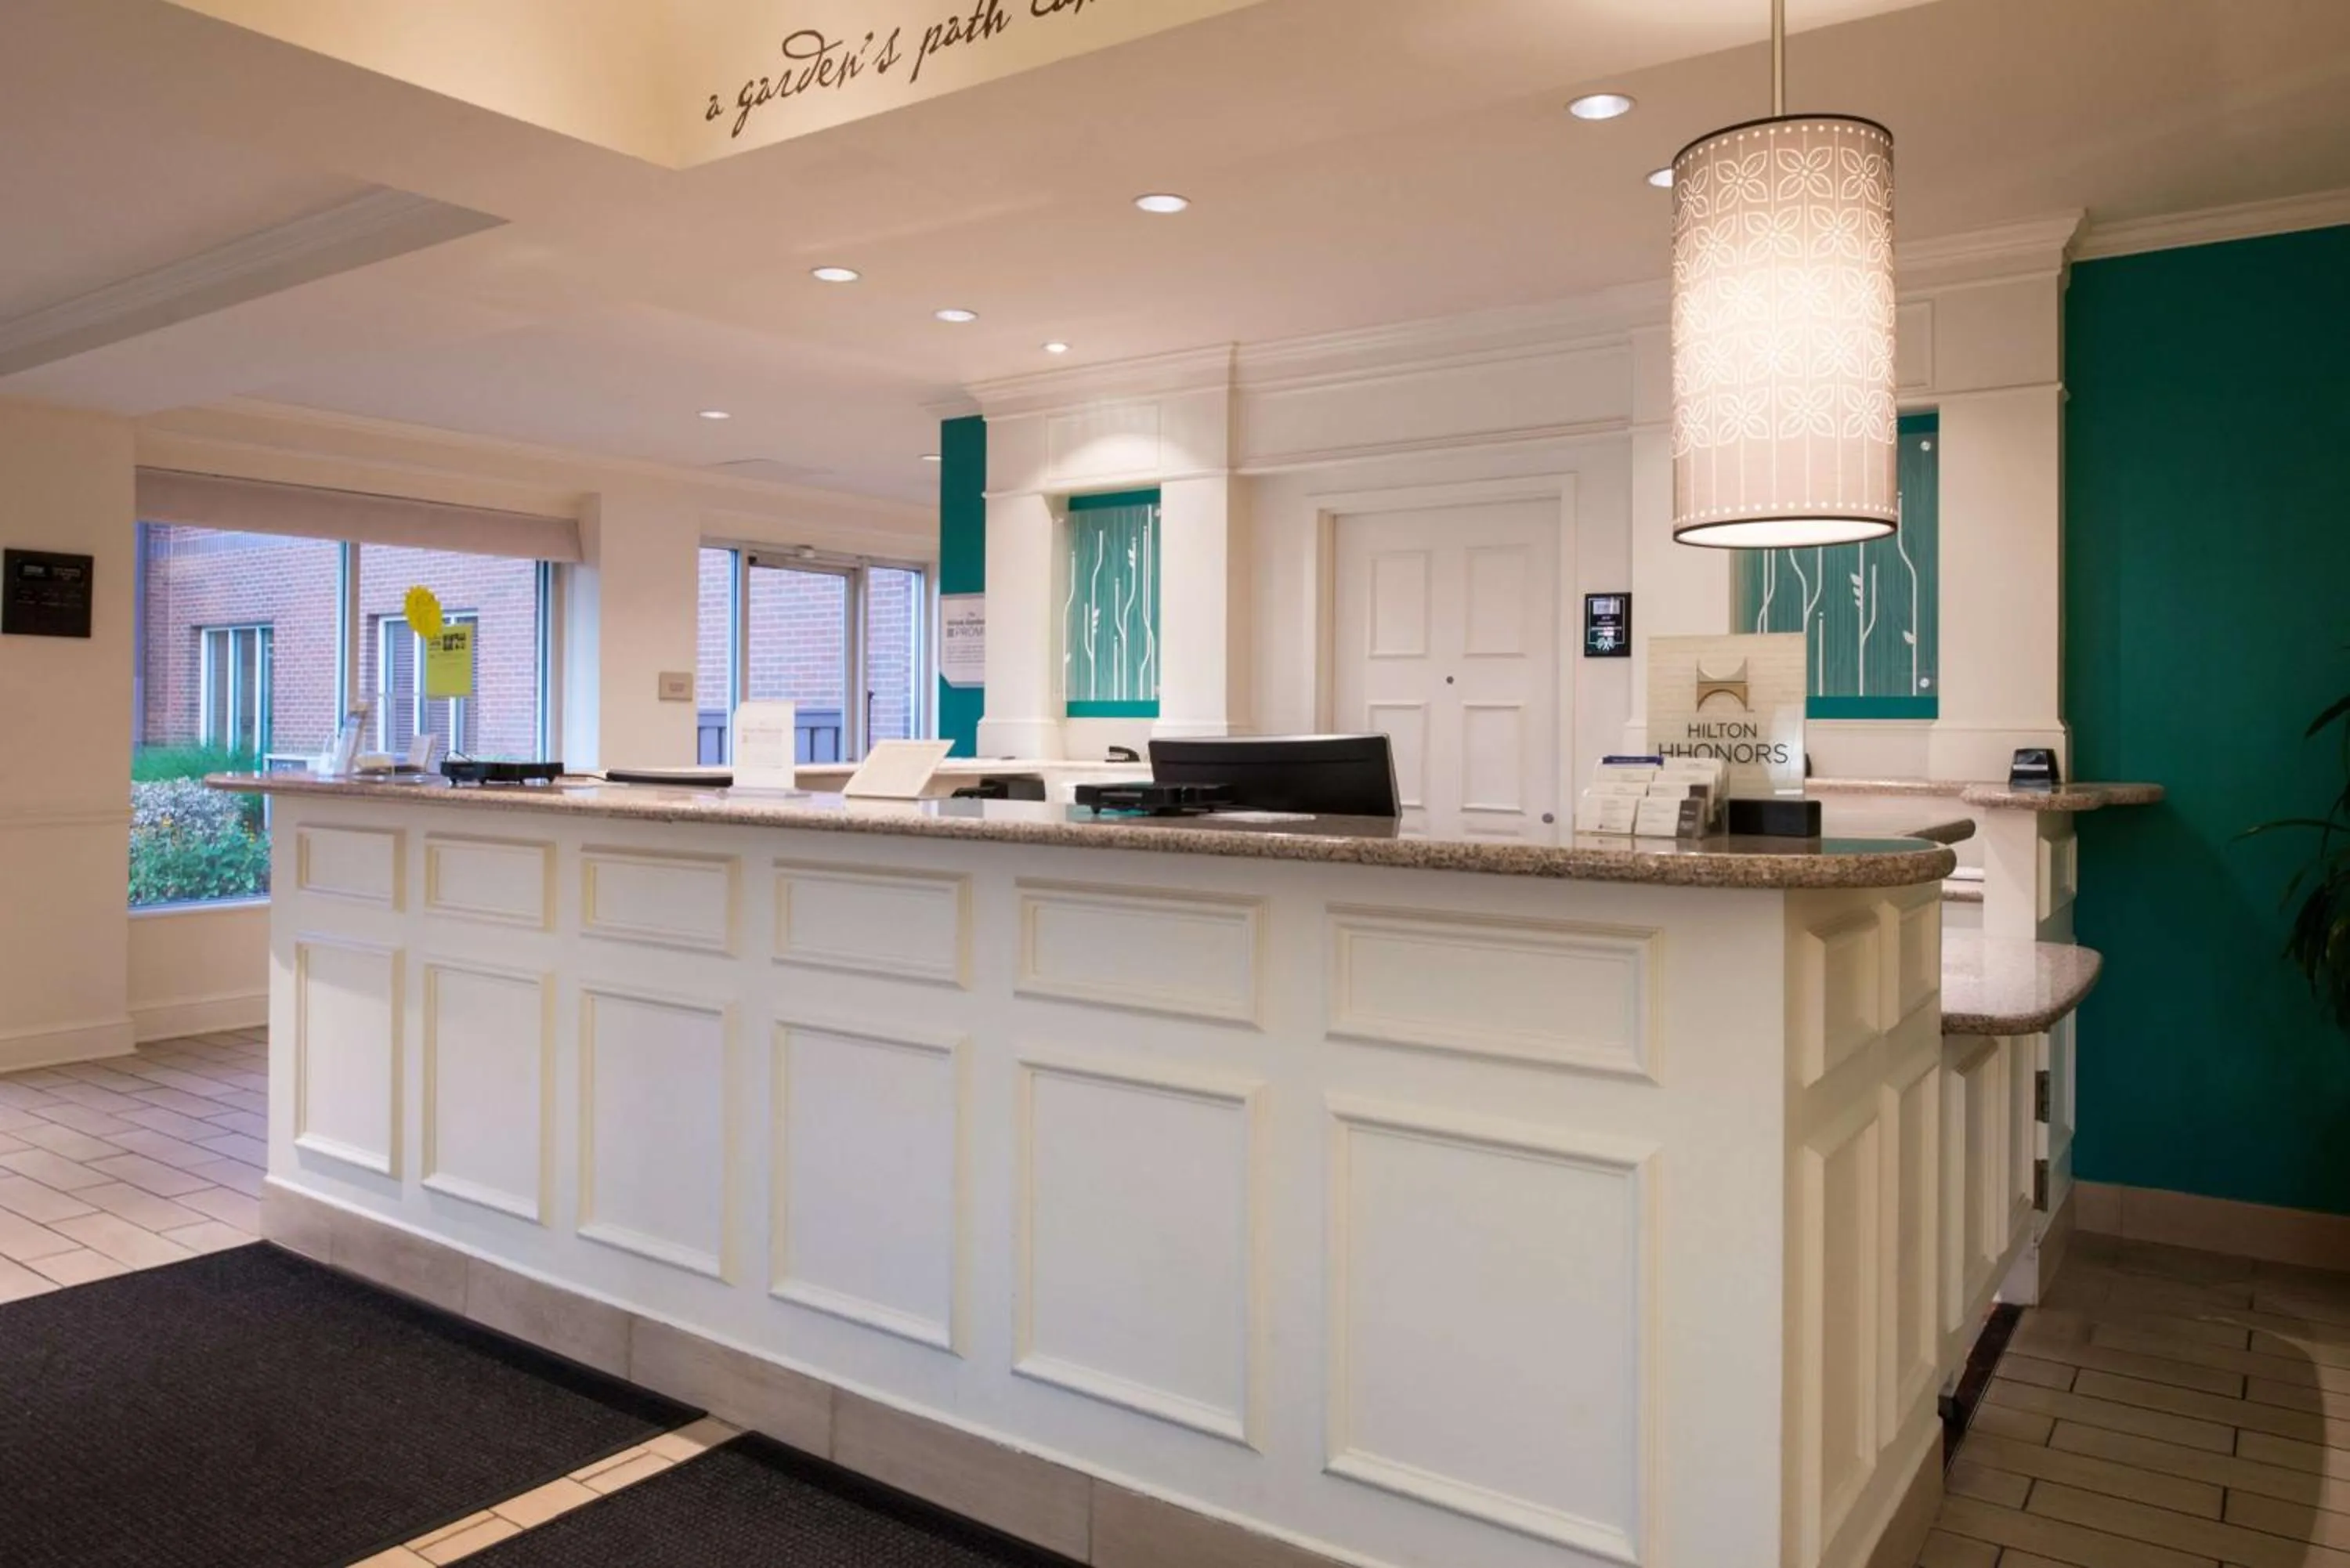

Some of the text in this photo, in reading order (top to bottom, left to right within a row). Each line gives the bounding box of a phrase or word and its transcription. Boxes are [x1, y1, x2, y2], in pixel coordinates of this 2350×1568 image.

[704, 0, 1013, 139] a garden's path
[1688, 722, 1758, 739] HILTON
[1658, 742, 1789, 764] HHONORS
